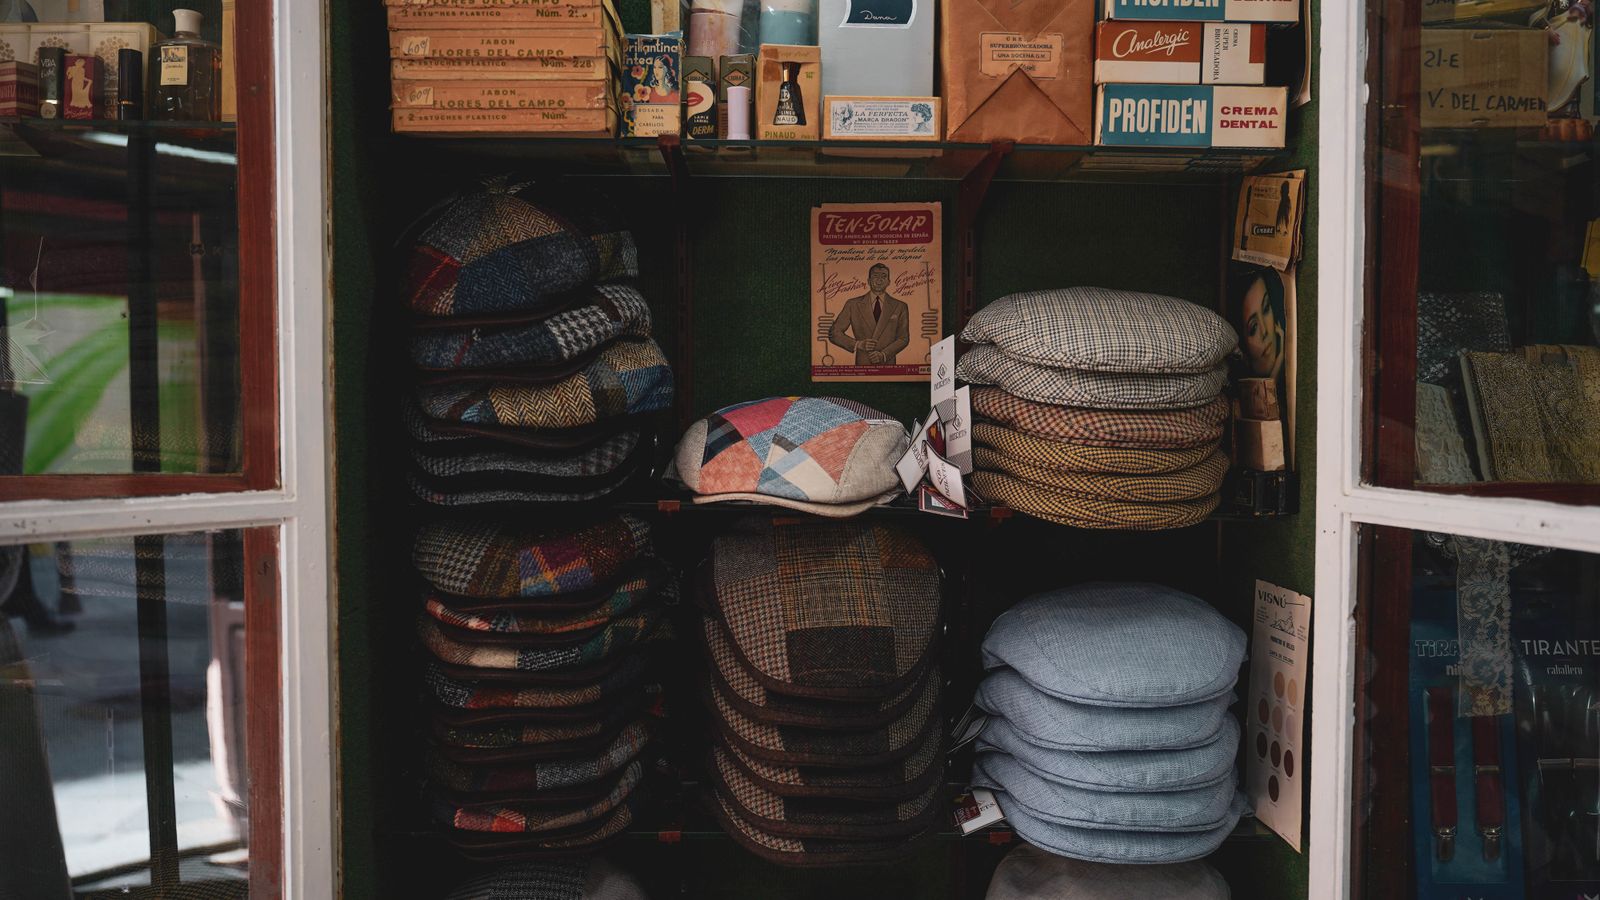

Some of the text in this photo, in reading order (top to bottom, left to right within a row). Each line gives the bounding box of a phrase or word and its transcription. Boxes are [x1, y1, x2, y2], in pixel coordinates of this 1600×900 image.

[860, 10, 897, 20] Dana
[1112, 28, 1191, 58] Analergic
[1222, 28, 1230, 51] SUPER
[431, 49, 565, 57] FLORES DEL CAMPO
[1212, 28, 1221, 81] BRONCEADORA
[432, 99, 566, 108] FLORES DEL CAMPO
[1427, 87, 1445, 109] V.
[1451, 92, 1481, 111] DEL
[407, 113, 416, 122] 2
[1108, 97, 1279, 134] PROFIDÉN CREMA
[1219, 120, 1279, 129] DENTAL
[764, 131, 796, 139] PINAUD
[825, 213, 928, 233] TEN-SOLAP
[1258, 589, 1287, 609] VISNÚ
